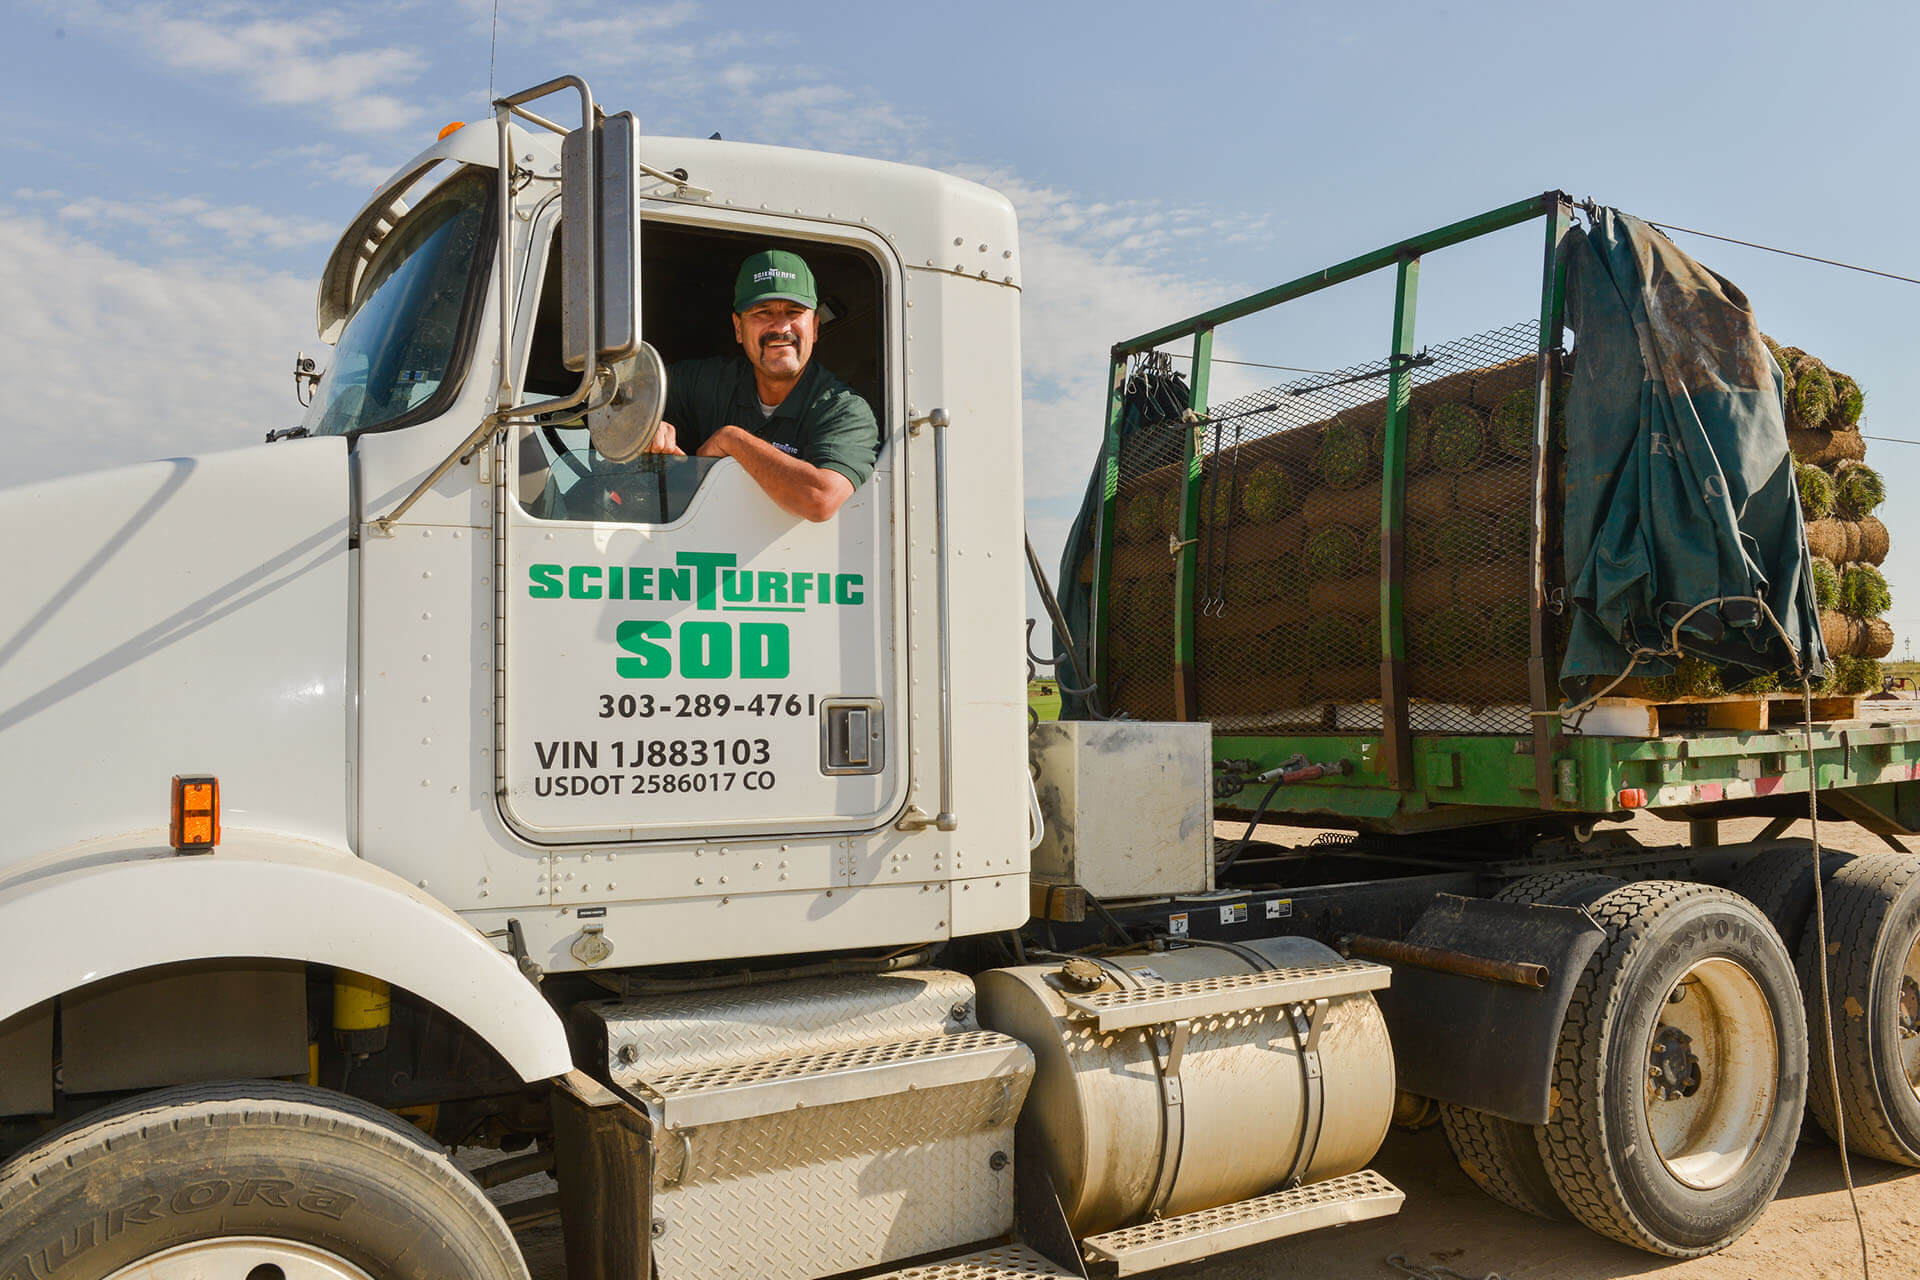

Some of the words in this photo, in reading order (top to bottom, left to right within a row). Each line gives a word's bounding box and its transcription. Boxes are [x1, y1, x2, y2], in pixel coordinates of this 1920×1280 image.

[528, 551, 864, 612] SCIENTURFIC
[616, 620, 790, 679] SOD
[598, 693, 815, 719] 303-289-4761
[534, 740, 598, 770] VIN
[610, 738, 771, 769] 1J883103
[534, 774, 625, 797] USDOT
[631, 771, 736, 794] 2586017
[743, 770, 776, 791] CO
